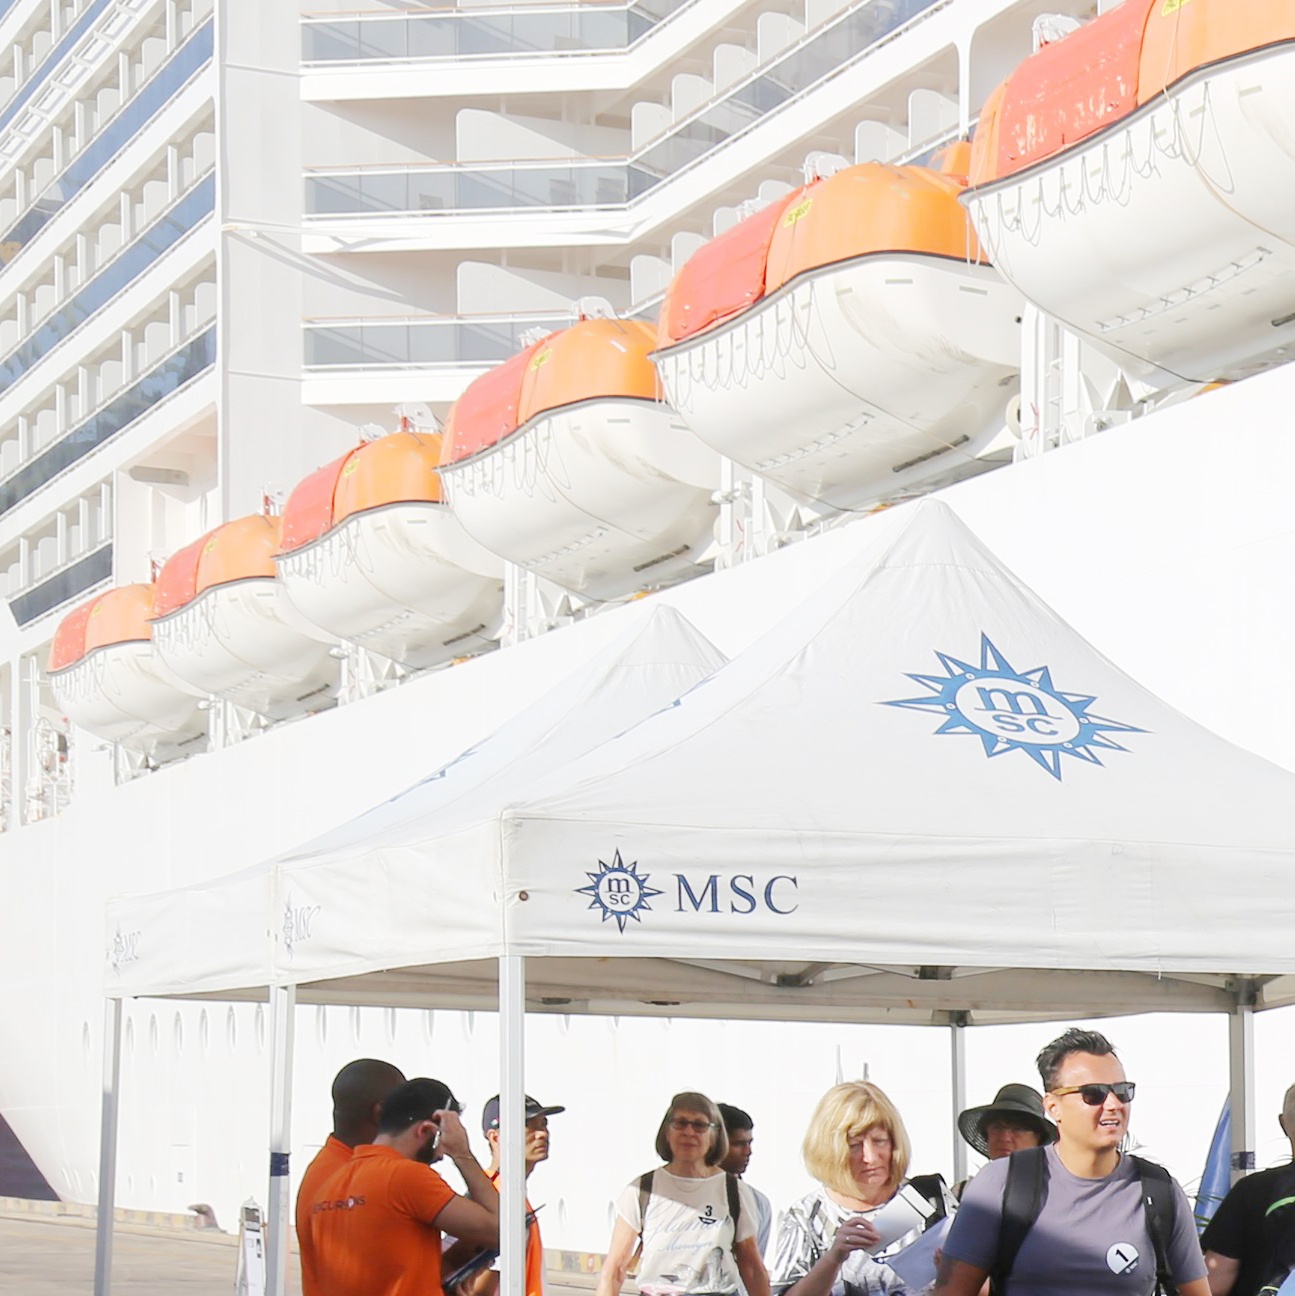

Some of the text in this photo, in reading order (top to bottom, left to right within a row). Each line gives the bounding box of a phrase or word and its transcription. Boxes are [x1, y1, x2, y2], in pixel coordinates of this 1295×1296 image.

[672, 873, 799, 915] MSC
[705, 1205, 713, 1217] 3
[1116, 1249, 1129, 1262] 1
